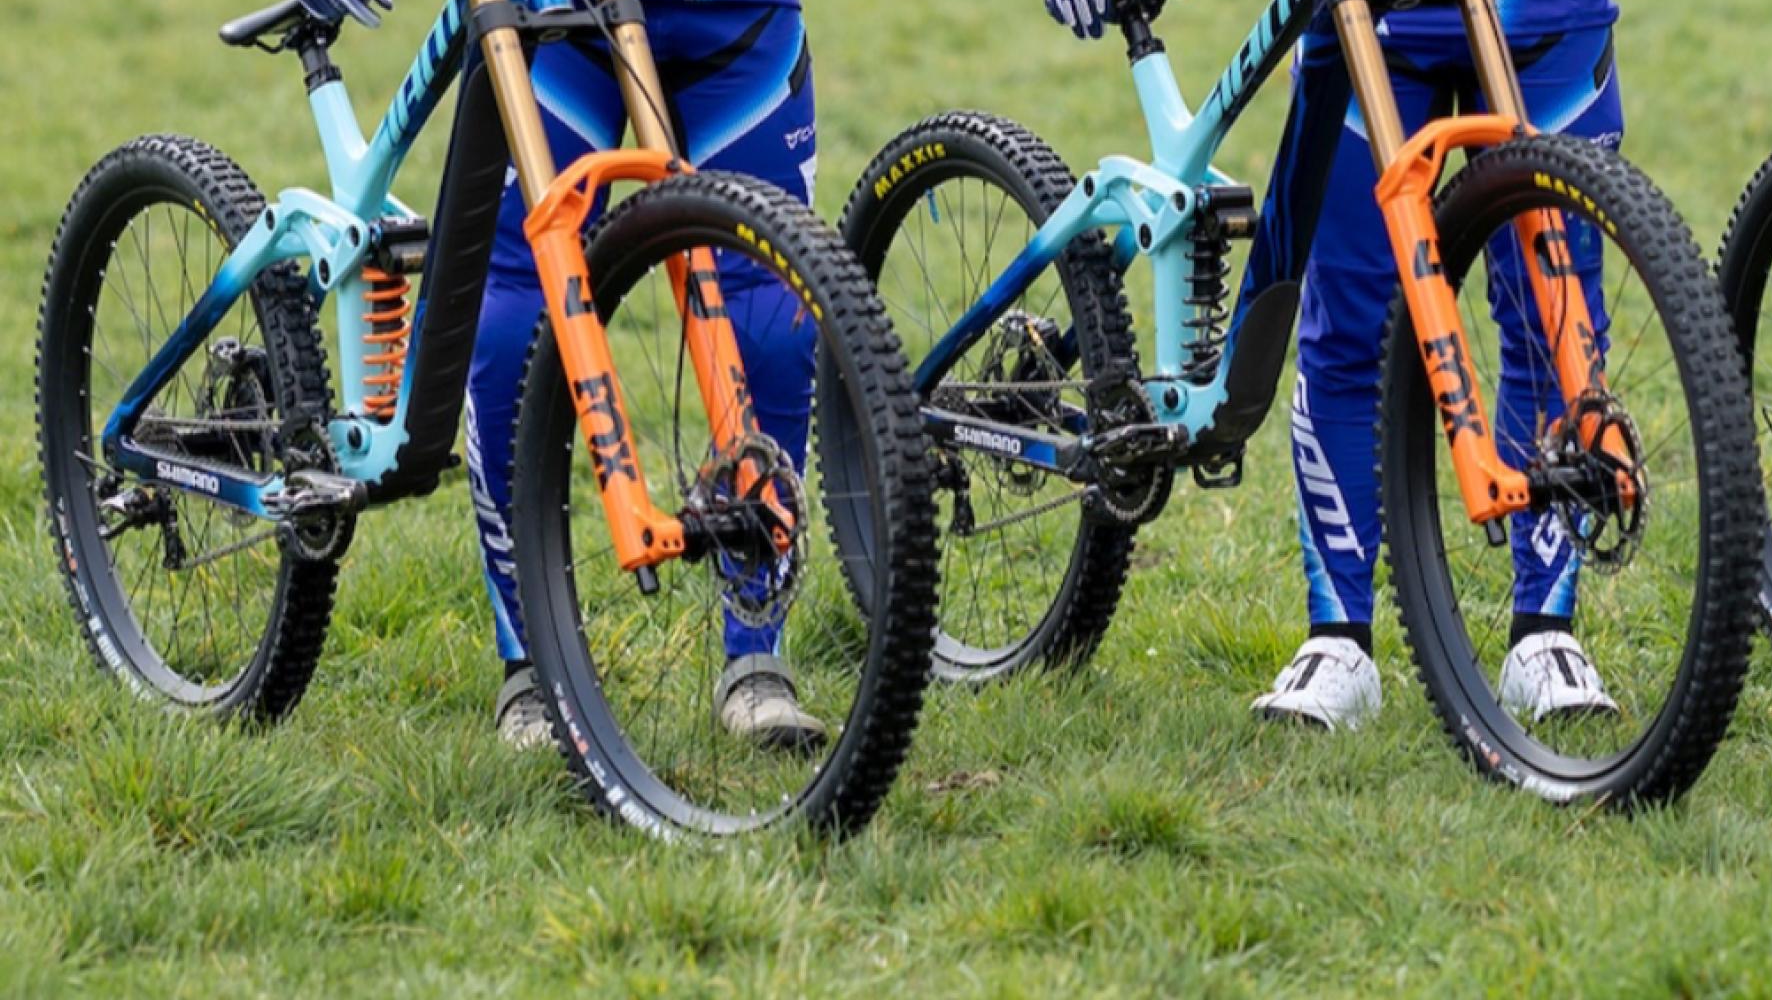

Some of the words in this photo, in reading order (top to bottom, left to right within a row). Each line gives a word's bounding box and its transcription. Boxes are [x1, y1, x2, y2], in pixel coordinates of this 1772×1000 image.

[874, 142, 946, 200] MAXXIS
[1534, 171, 1617, 238] MAXXIS
[736, 222, 824, 321] MAXXIS
[954, 424, 1021, 455] SHIMANO
